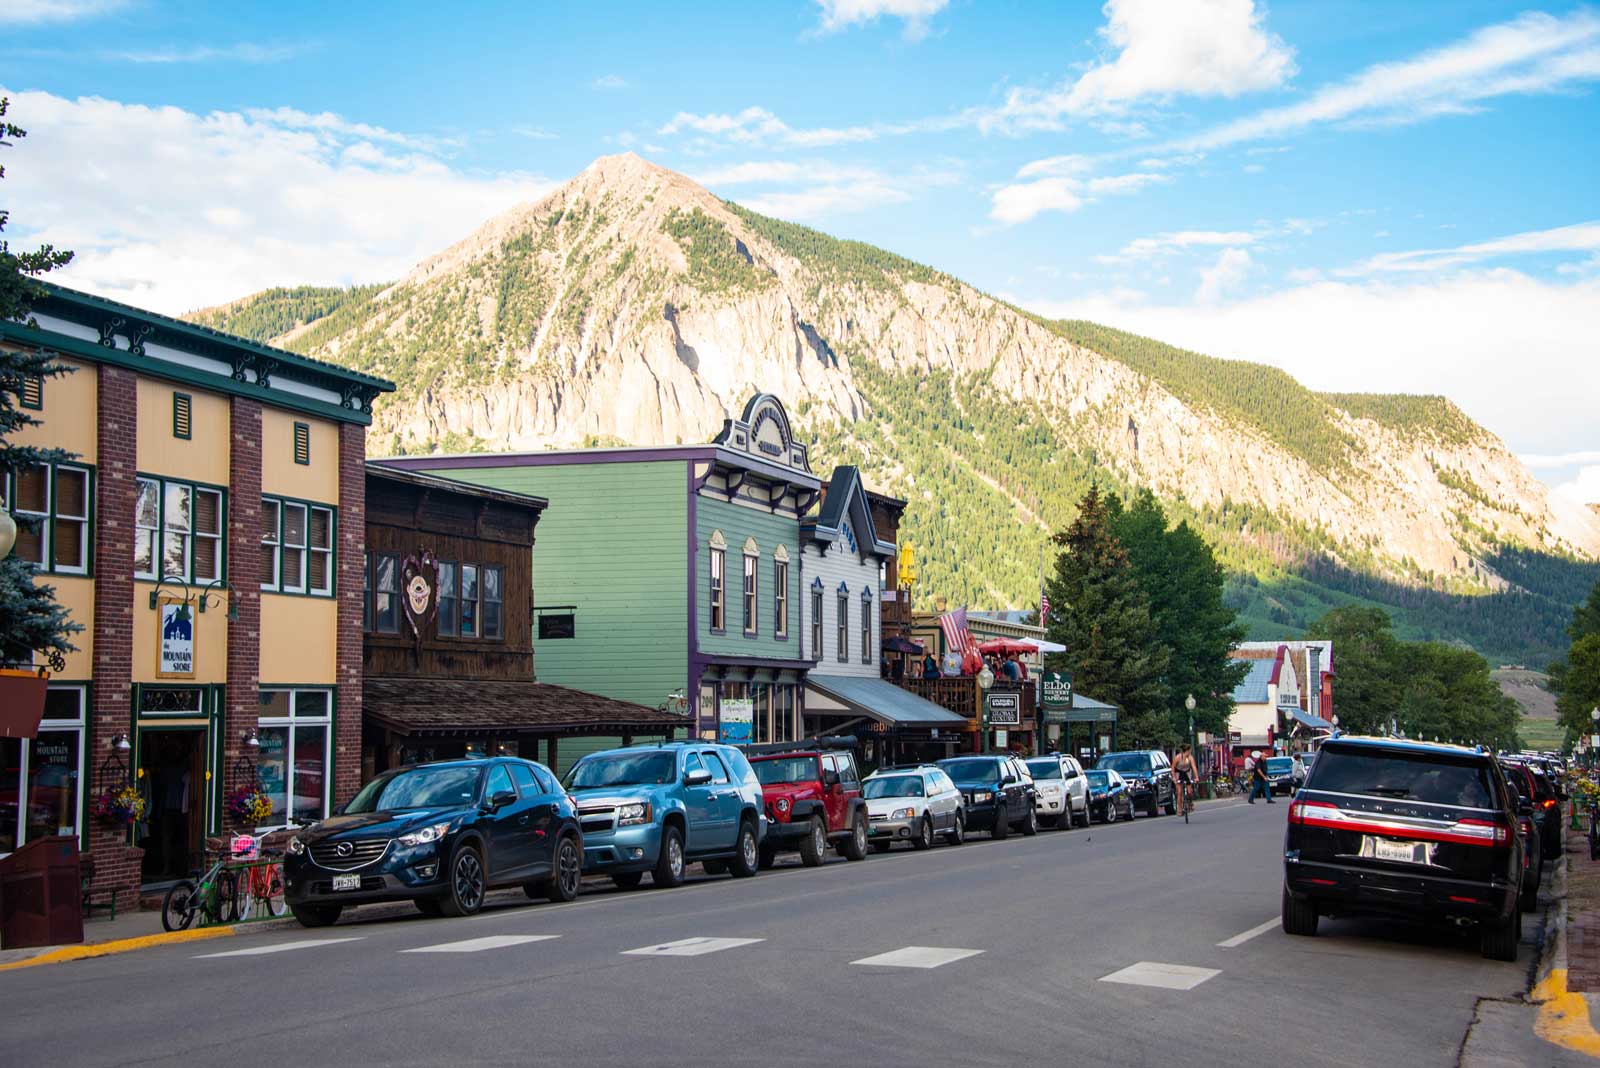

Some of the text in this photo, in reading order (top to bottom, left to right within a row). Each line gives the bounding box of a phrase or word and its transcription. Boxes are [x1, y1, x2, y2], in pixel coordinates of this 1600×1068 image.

[163, 651, 191, 661] MOUNTAIN
[173, 663, 191, 671] STORE
[1044, 681, 1071, 690] ELDO
[37, 746, 68, 754] MOUNTAIN
